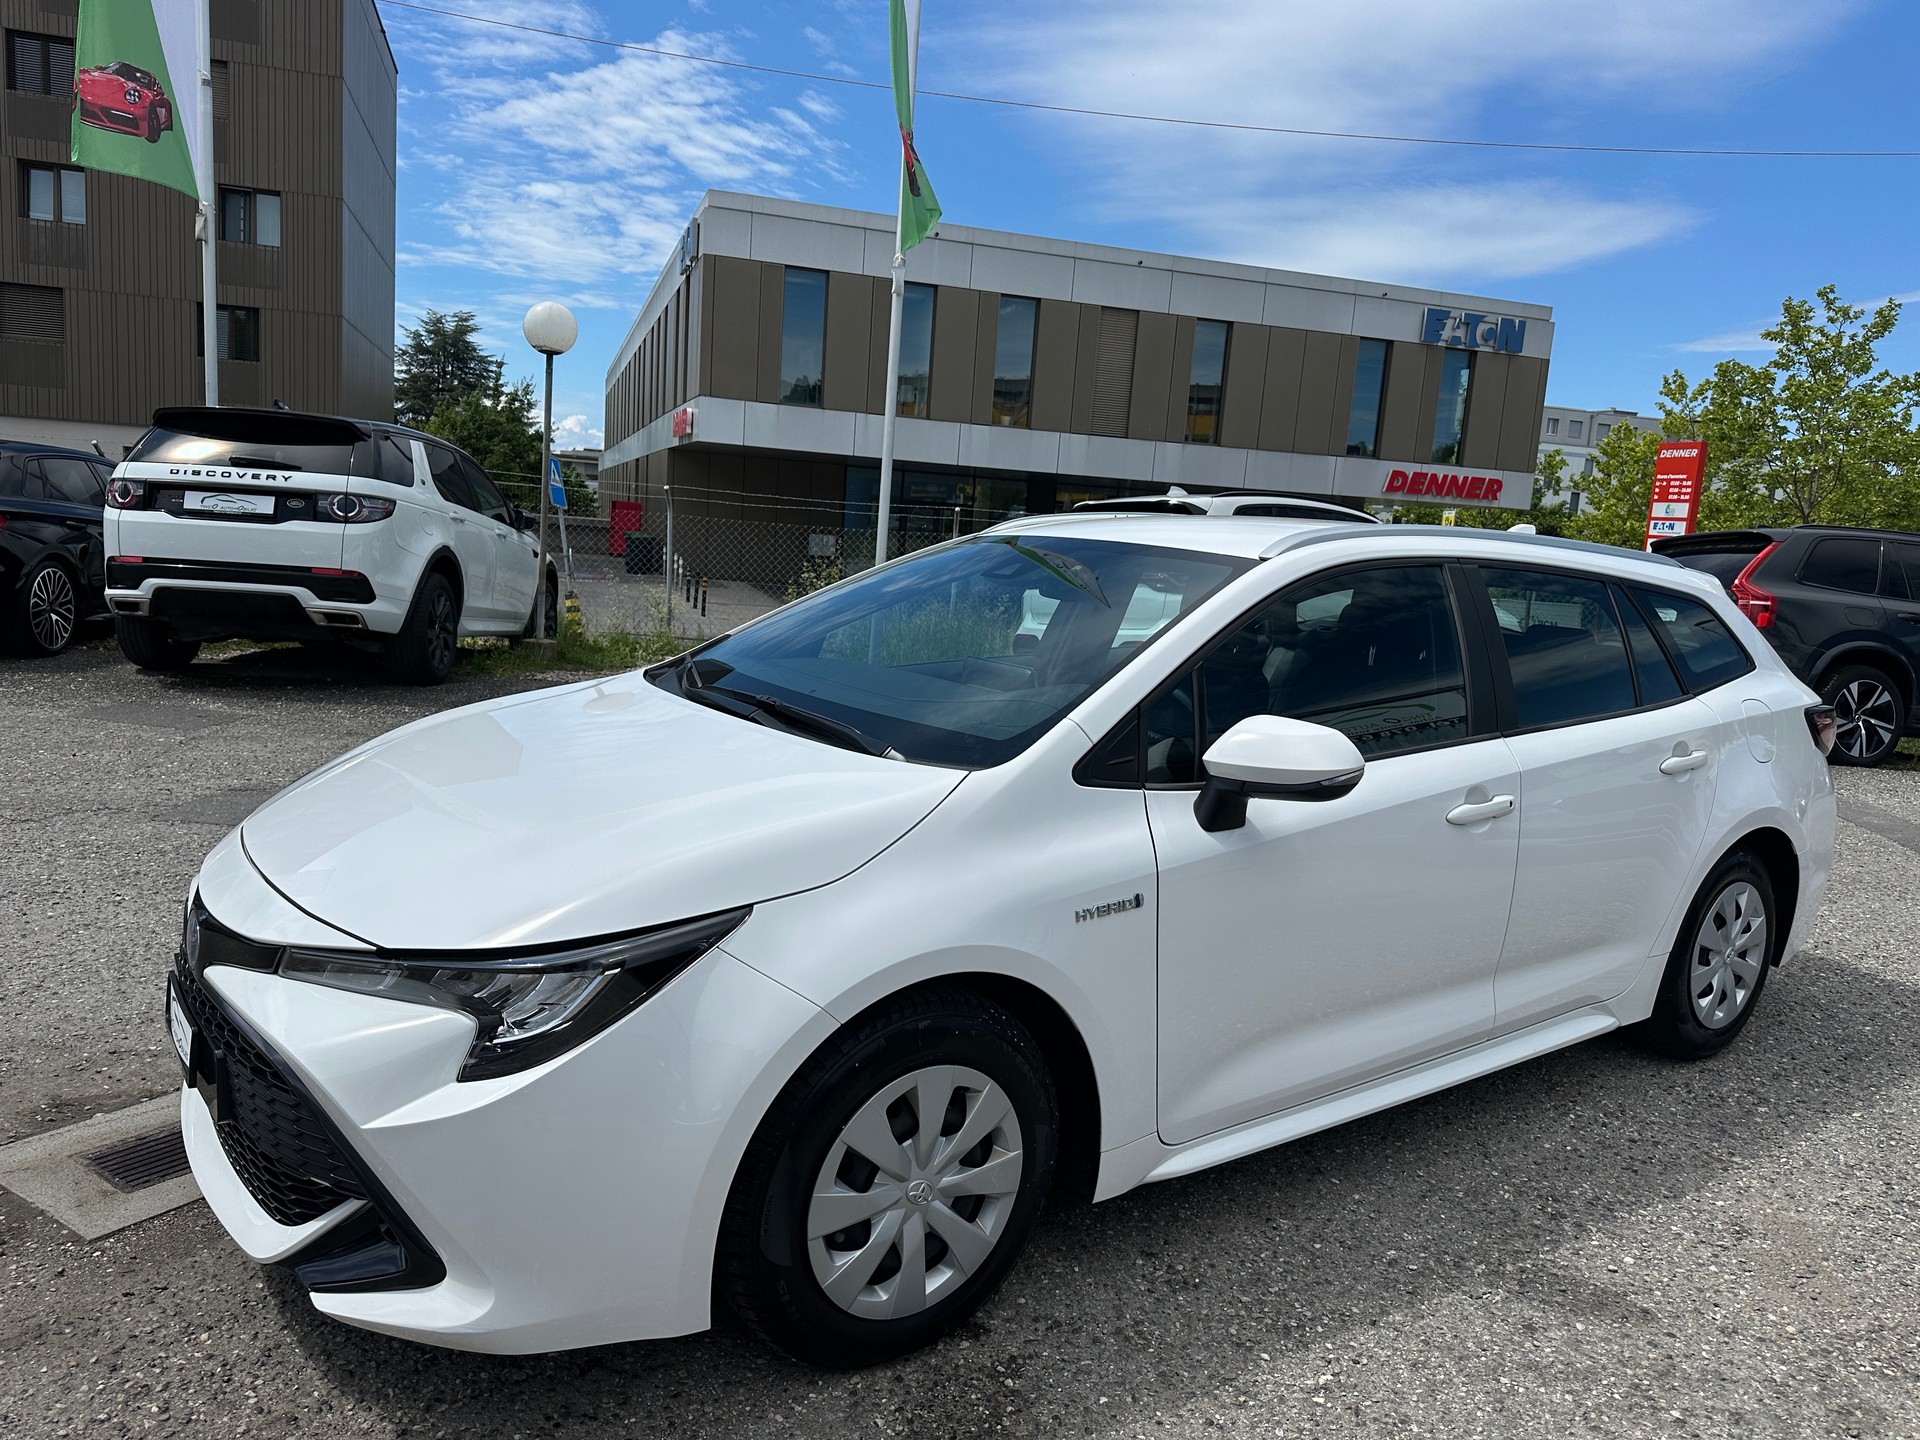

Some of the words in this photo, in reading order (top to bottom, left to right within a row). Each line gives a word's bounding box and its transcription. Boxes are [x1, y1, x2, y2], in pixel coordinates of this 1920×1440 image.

[1421, 307, 1527, 353] EATON
[1660, 448, 1698, 458] DENNER
[169, 468, 293, 482] DISCOVERY
[1383, 469, 1503, 501] DENNER
[1074, 896, 1134, 924] HYBRID
